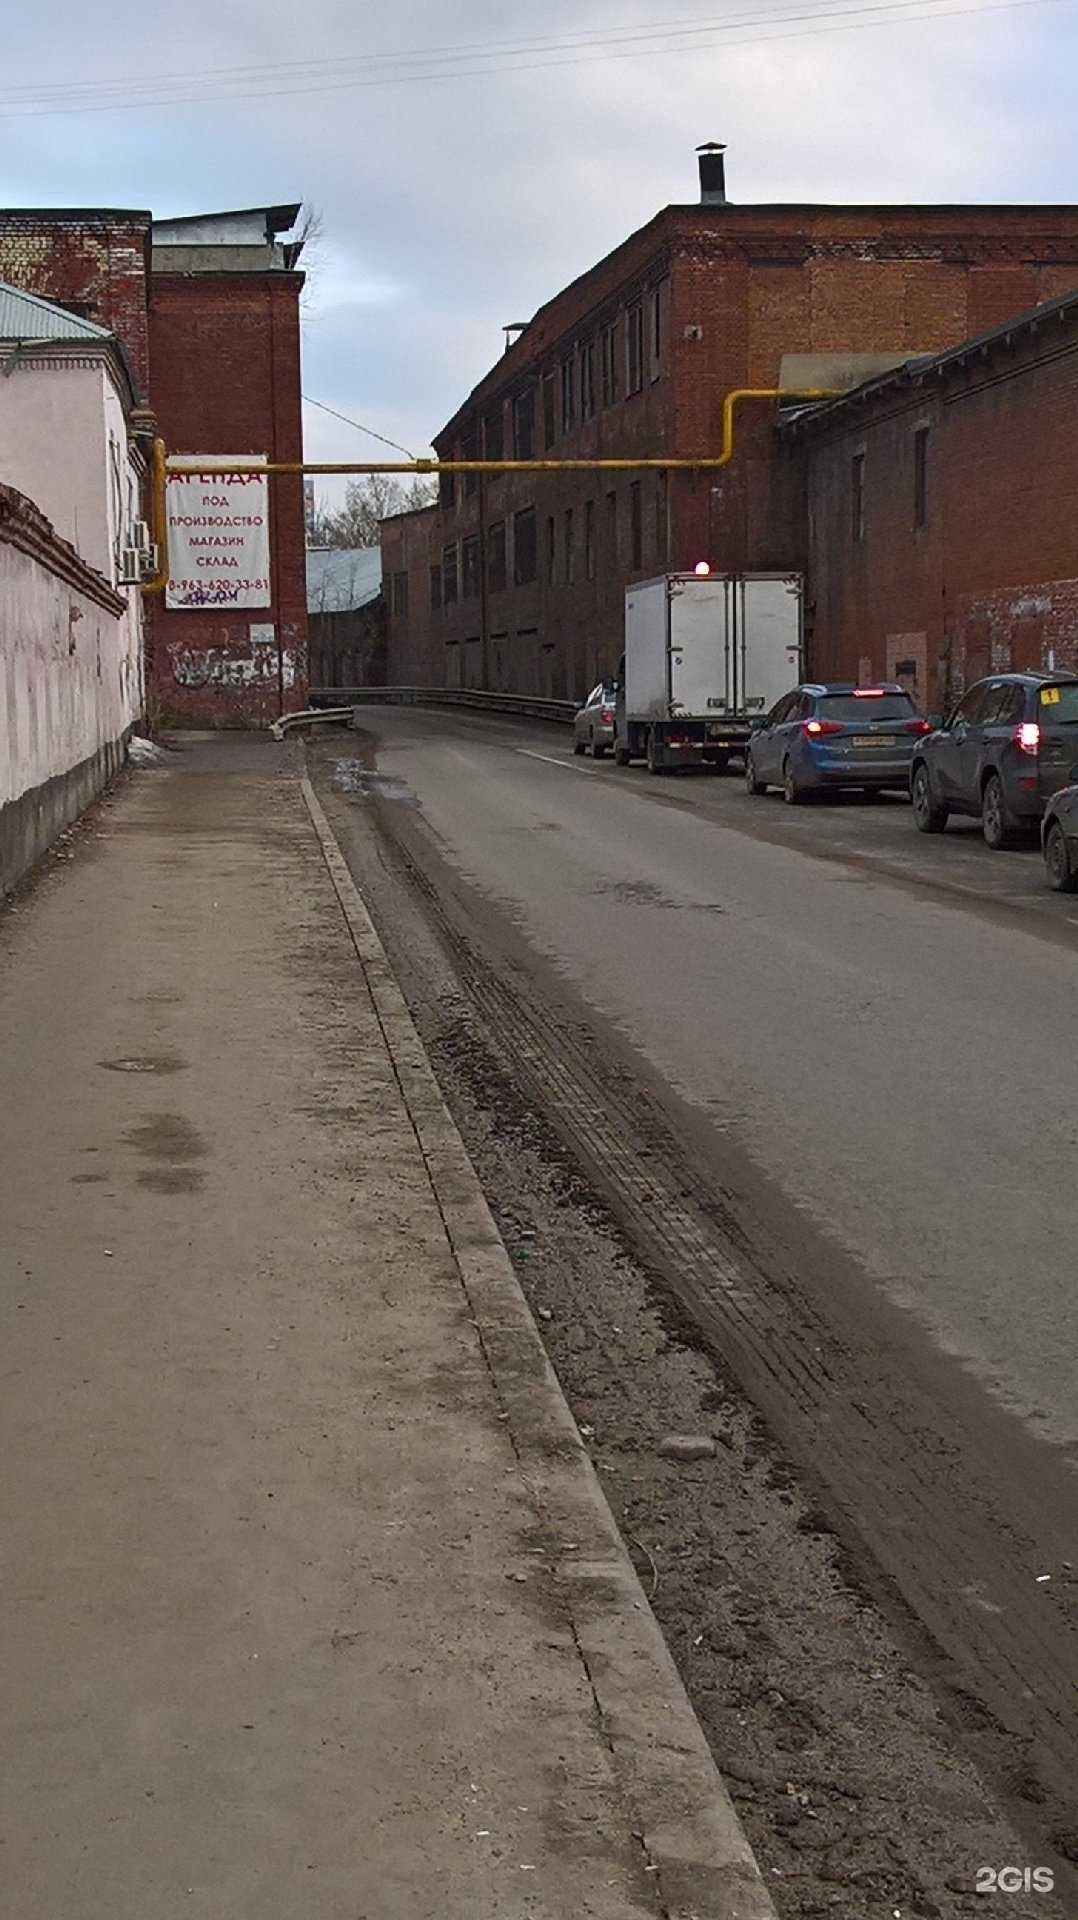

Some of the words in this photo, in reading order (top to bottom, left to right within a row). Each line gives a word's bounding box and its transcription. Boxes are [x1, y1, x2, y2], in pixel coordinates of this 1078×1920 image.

[202, 496, 230, 506] ПОД
[168, 516, 264, 527] ПРОИЗВОДСТВО
[189, 537, 244, 546] МАГАЗИН
[196, 557, 239, 567] СКЛАД
[168, 579, 269, 590] 8-963-620-33-81
